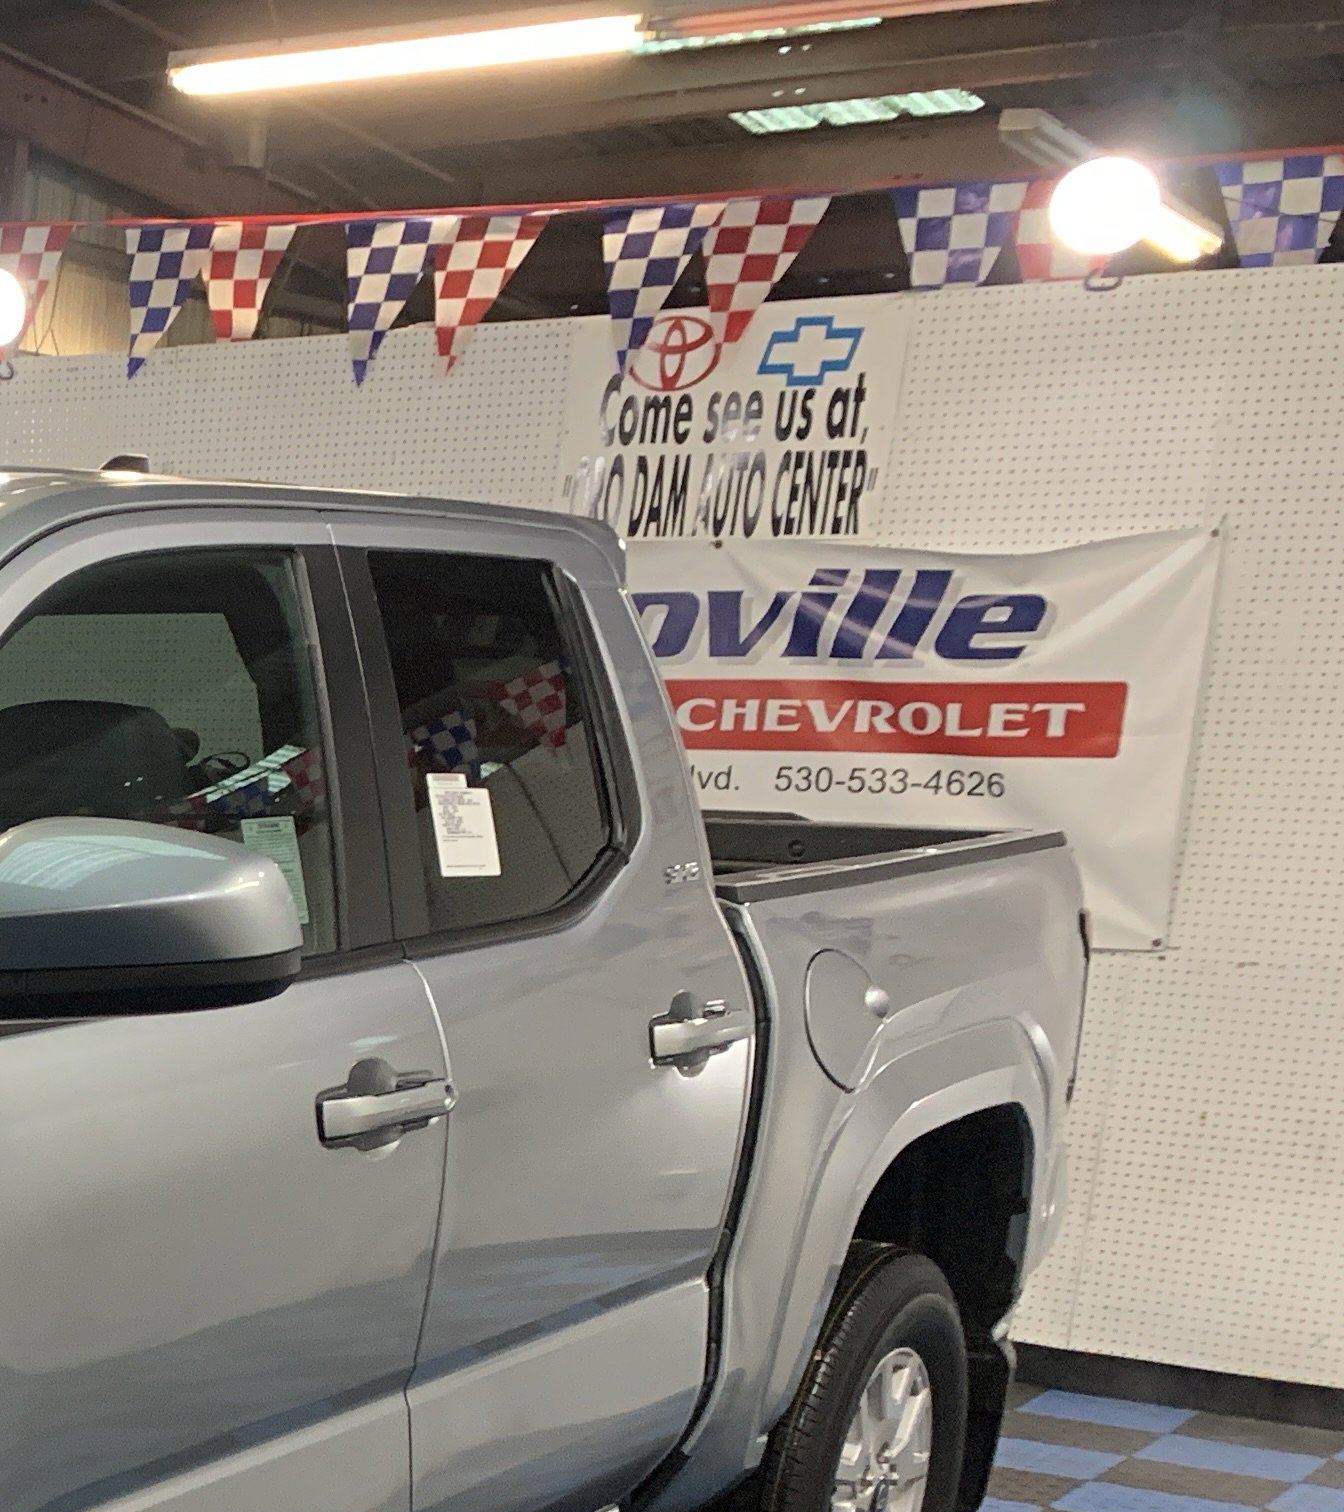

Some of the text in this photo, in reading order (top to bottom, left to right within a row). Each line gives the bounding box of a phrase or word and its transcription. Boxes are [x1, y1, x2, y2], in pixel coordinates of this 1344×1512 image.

[599, 372, 868, 446] Come see us at,
[627, 454, 691, 537] DAM
[692, 448, 766, 538] AUTO
[771, 449, 879, 537] CENTER"
[630, 568, 1050, 660] oville
[675, 697, 1086, 738] CHEVROLET
[692, 765, 1006, 798] vd. 530-533-4626
